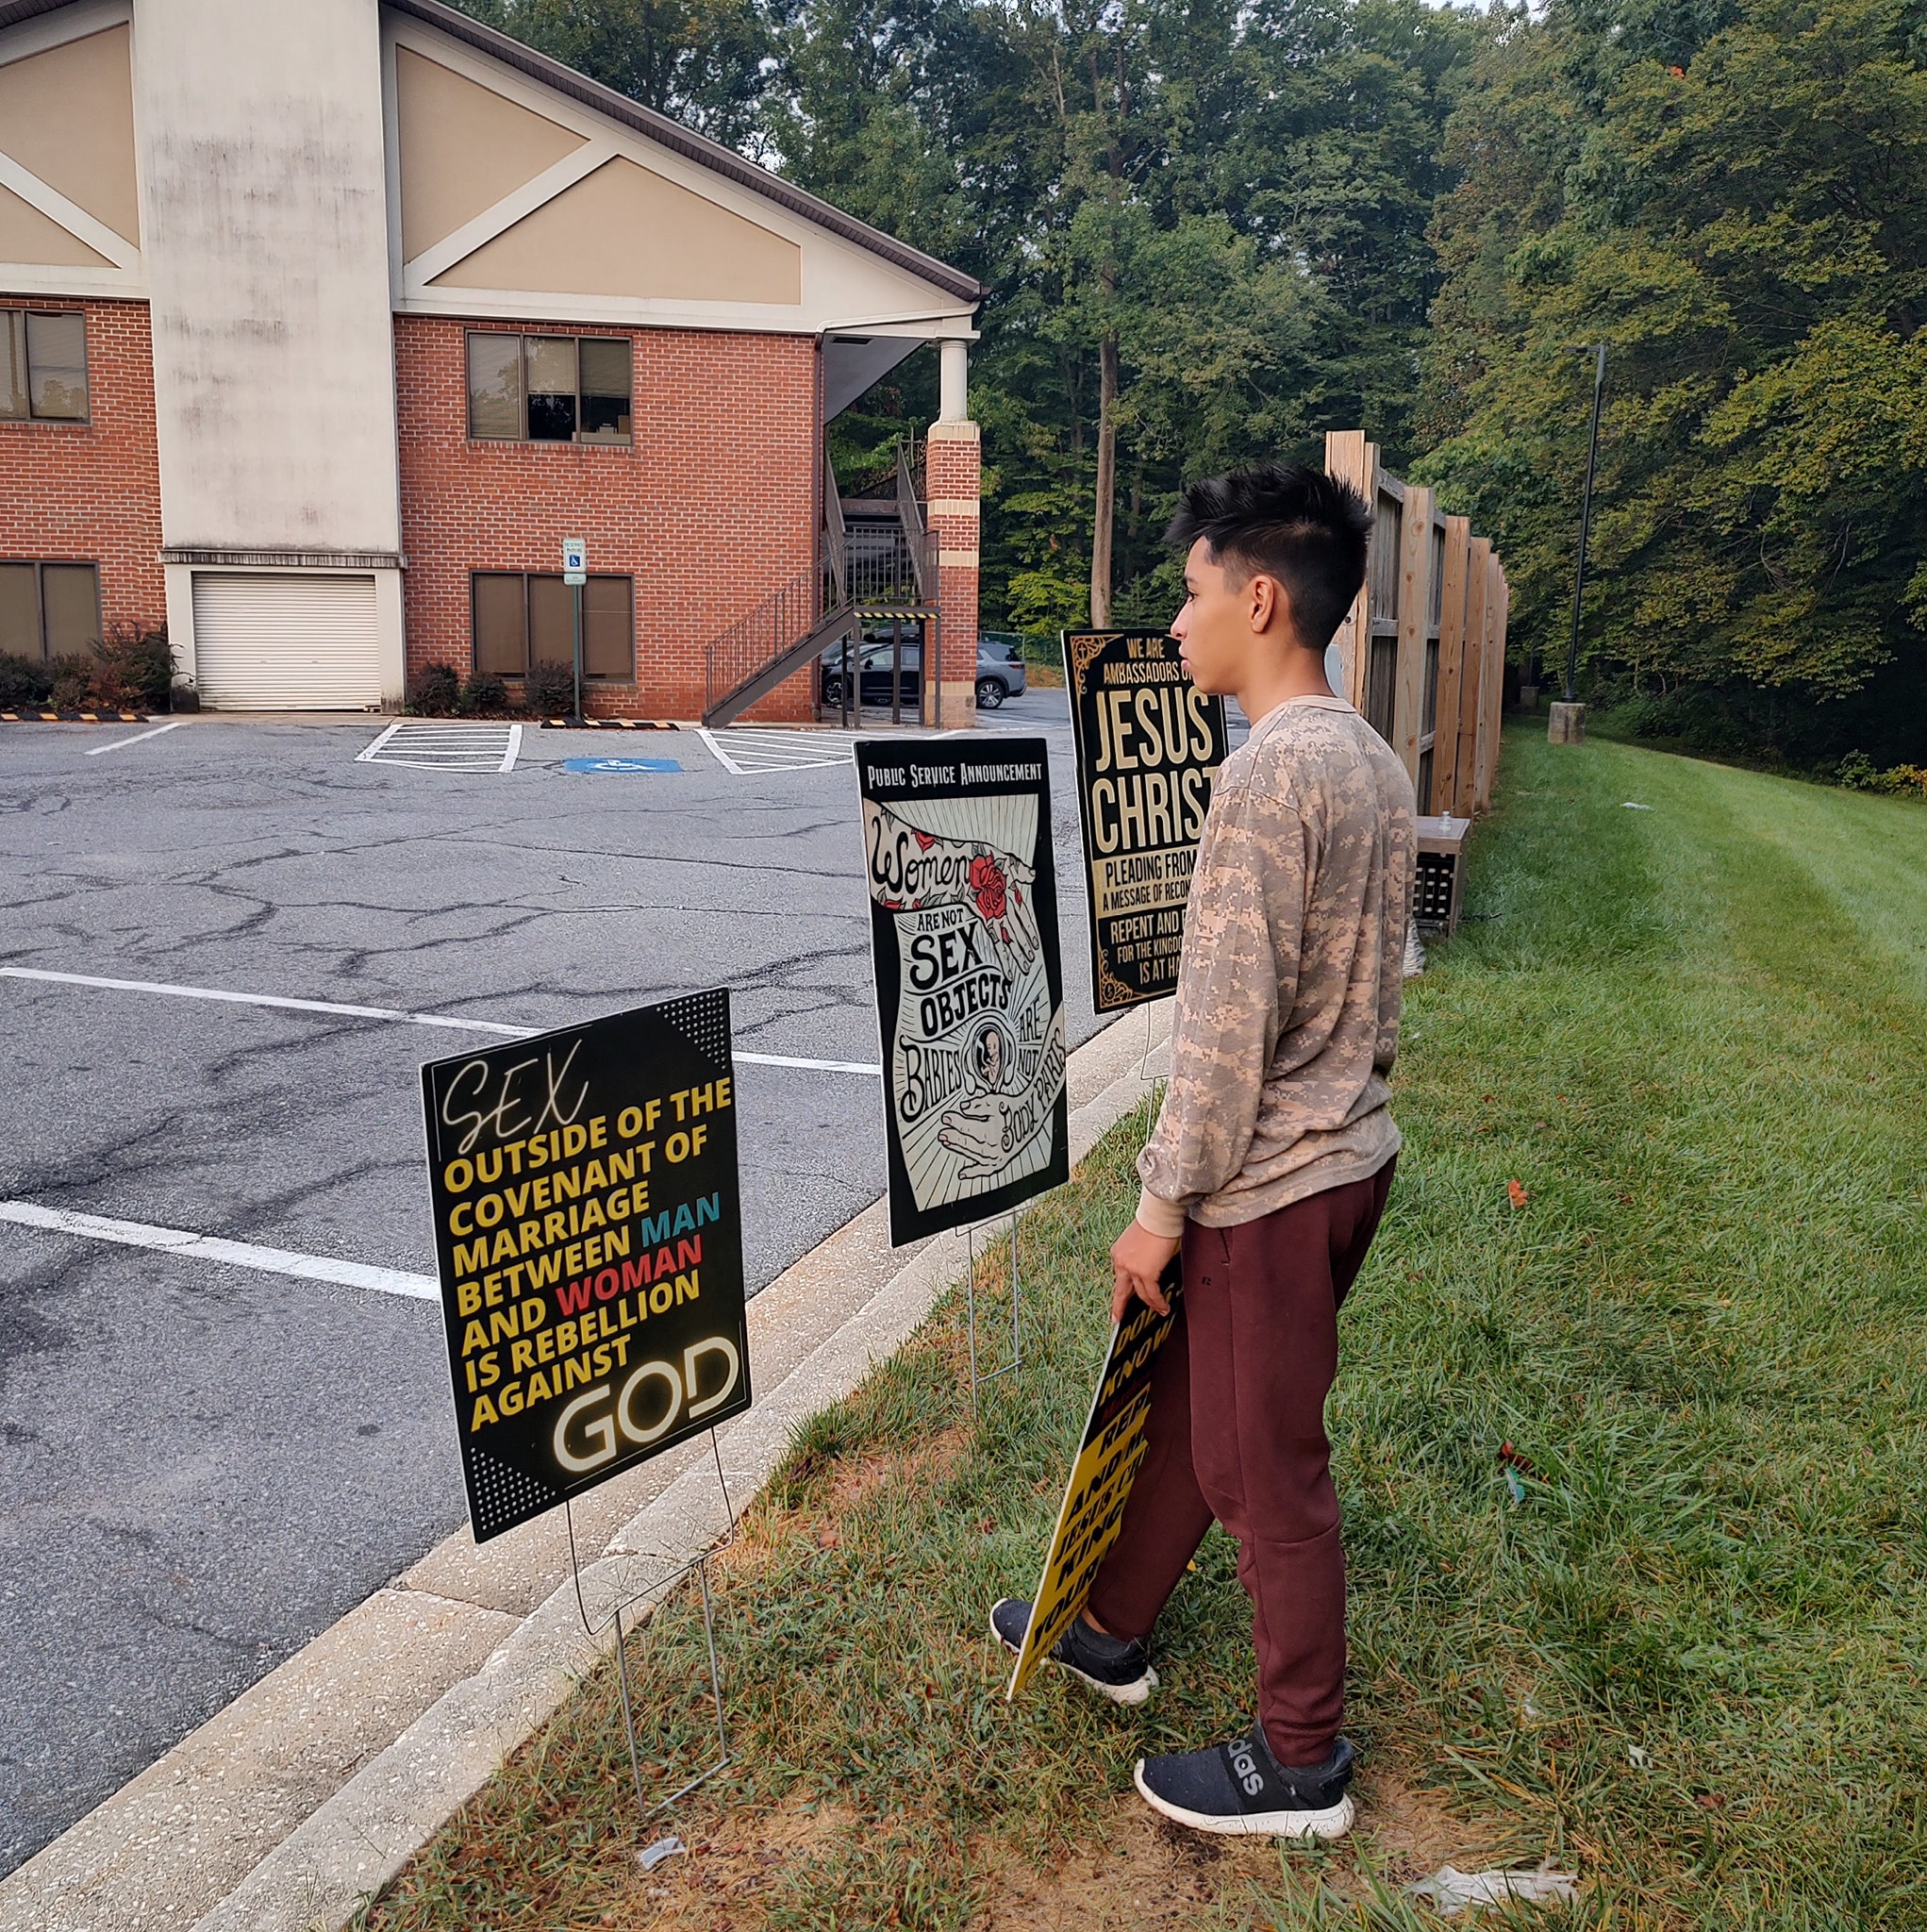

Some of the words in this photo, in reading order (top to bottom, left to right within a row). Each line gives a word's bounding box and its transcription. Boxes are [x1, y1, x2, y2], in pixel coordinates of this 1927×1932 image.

[1103, 661, 1180, 686] AMBASSADORS
[1126, 638, 1145, 659] WE
[1146, 637, 1166, 659] ARE
[1095, 685, 1214, 773] JESUS
[868, 764, 905, 790] PUBLIC
[910, 763, 956, 789] SERVICE
[960, 762, 1042, 786] ANNOUNCEMENT
[872, 815, 971, 894] Women
[1103, 892, 1109, 911] A
[1111, 884, 1151, 910] MESSAGE
[1153, 884, 1163, 903] OF
[1165, 877, 1192, 901] RECON
[1105, 855, 1162, 888] PLEADING
[1165, 848, 1198, 879] FROM
[909, 920, 983, 991] SEX
[917, 912, 940, 931] ARE
[941, 908, 964, 928] NOT
[1110, 913, 1155, 944] REPENT
[1156, 909, 1180, 935] AND
[1117, 945, 1134, 965] FOR
[1136, 940, 1153, 959] THE
[1154, 935, 1183, 957] KINGDO
[920, 973, 1011, 1037] OBJECTS
[1139, 960, 1151, 985] IS
[1152, 957, 1166, 982] AT
[1169, 955, 1181, 980] HA
[1019, 998, 1042, 1043] ARE
[442, 1039, 590, 1155] SEX
[899, 1034, 962, 1123] BABIES
[998, 1101, 1039, 1153] BODY
[1034, 1026, 1068, 1115] PARTS
[1018, 1047, 1040, 1081] NOT
[444, 1115, 608, 1193] OUTSIDE
[617, 1098, 662, 1139] OF
[670, 1076, 732, 1123] THE
[449, 1141, 656, 1237] COVENANT
[665, 1124, 708, 1163] OF
[452, 1181, 650, 1277] MARRIAGE
[457, 1224, 631, 1318] BETWEEN
[640, 1191, 721, 1248] MAN
[461, 1296, 547, 1357] AND
[555, 1235, 703, 1316] WOMAN
[465, 1351, 500, 1393] IS
[510, 1269, 701, 1374] REBELLION
[472, 1333, 631, 1433] AGAINST
[1099, 1312, 1176, 1407] KNOW
[554, 1335, 739, 1472] GOD
[1054, 1484, 1114, 1567] JESUS
[1064, 1449, 1122, 1528] AND
[1055, 1496, 1124, 1591] KING
[1033, 1556, 1100, 1650] YOUR
[1227, 1739, 1264, 1796] das
